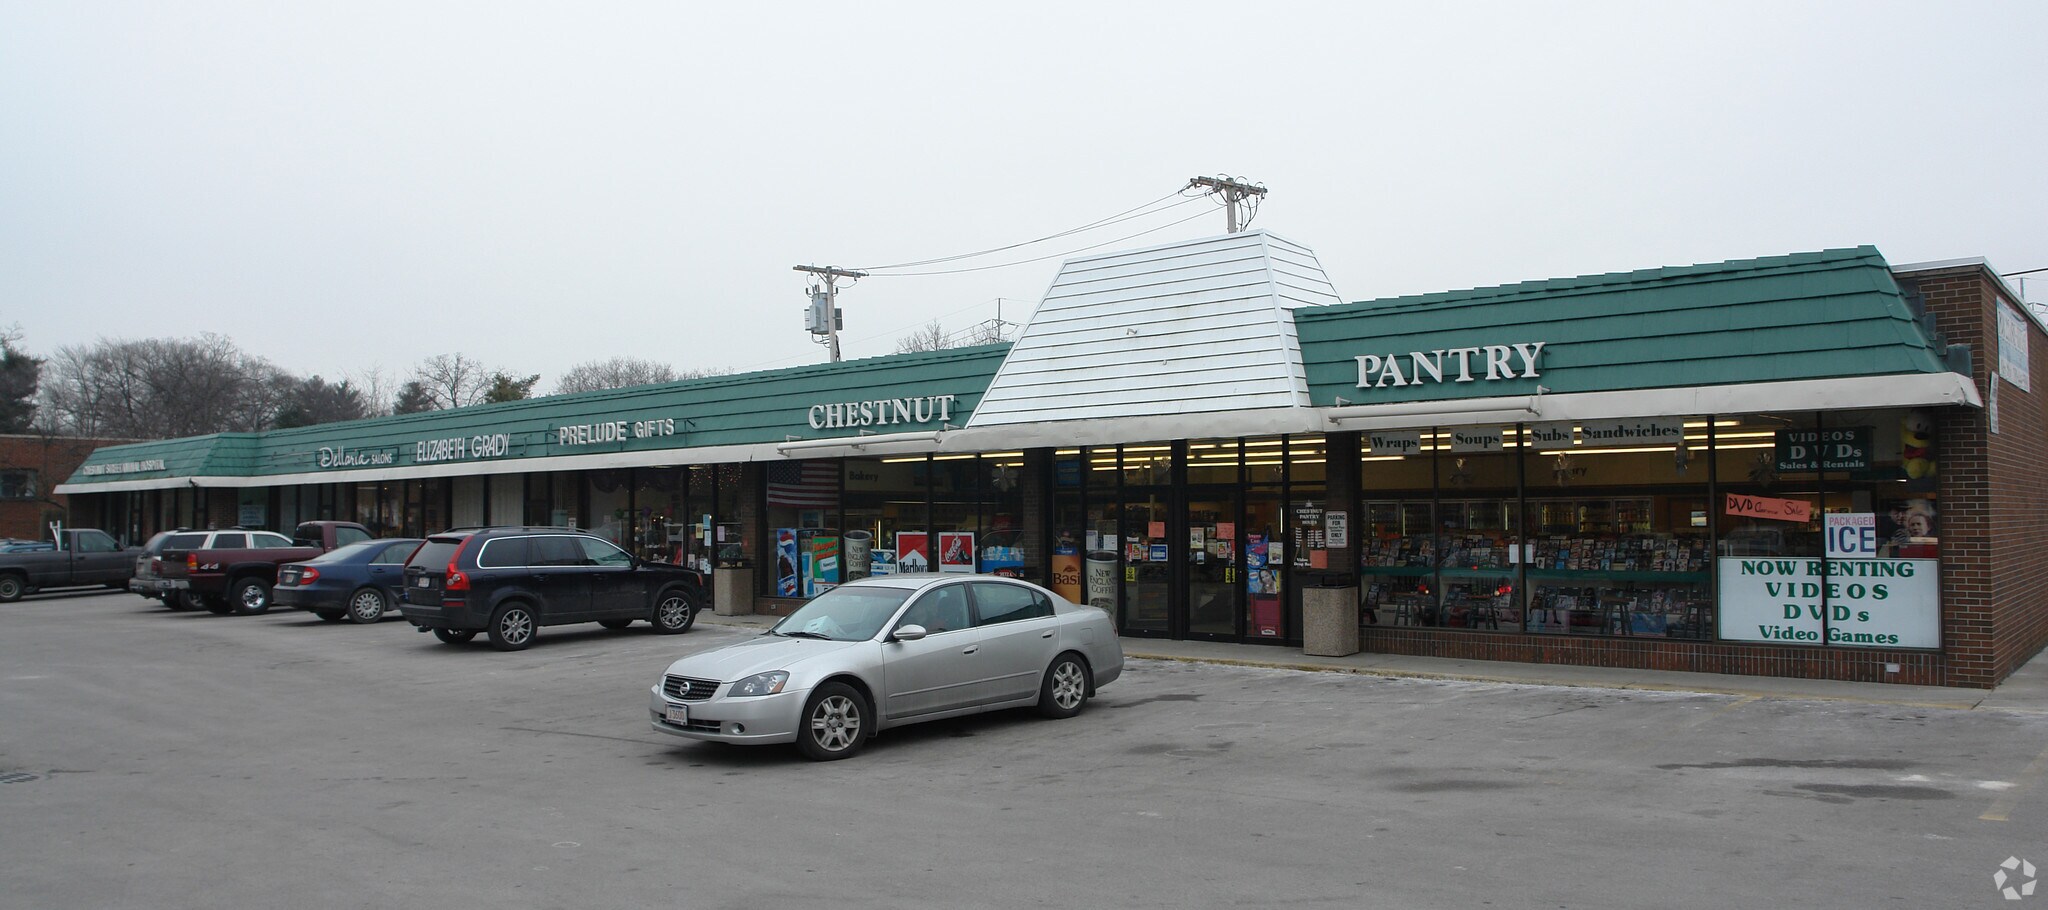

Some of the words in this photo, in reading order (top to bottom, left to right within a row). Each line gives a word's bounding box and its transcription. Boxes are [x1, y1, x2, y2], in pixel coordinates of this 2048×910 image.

[1354, 341, 1546, 388] PANTRY
[808, 395, 955, 429] CHESTNUT
[559, 421, 627, 446] PRELUDE
[635, 418, 675, 438] GIFTS
[1532, 428, 1569, 441] Subs
[1582, 423, 1679, 439] Sandwiches
[1789, 430, 1855, 442] VIDEOS
[416, 437, 465, 462] ELIZABETH
[471, 433, 510, 458] GRADY
[1372, 436, 1418, 451] Wraps
[1455, 432, 1500, 449] Soups
[319, 446, 370, 468] Dellaria
[371, 453, 392, 464] SALONS
[1779, 461, 1807, 469] Sales
[1823, 460, 1865, 468] Rentals
[848, 471, 878, 483] Bakery
[1728, 497, 1753, 512] DVD
[1829, 516, 1874, 526] PACKAGED
[1829, 526, 1875, 553] ICE
[1095, 568, 1111, 577] NEW
[1741, 560, 1797, 576] NOW
[1806, 561, 1914, 577] RENTING
[1053, 572, 1080, 585] Basi
[1765, 582, 1888, 600] VIDEOS
[1759, 625, 1818, 641] Video
[1827, 627, 1899, 644] Games
